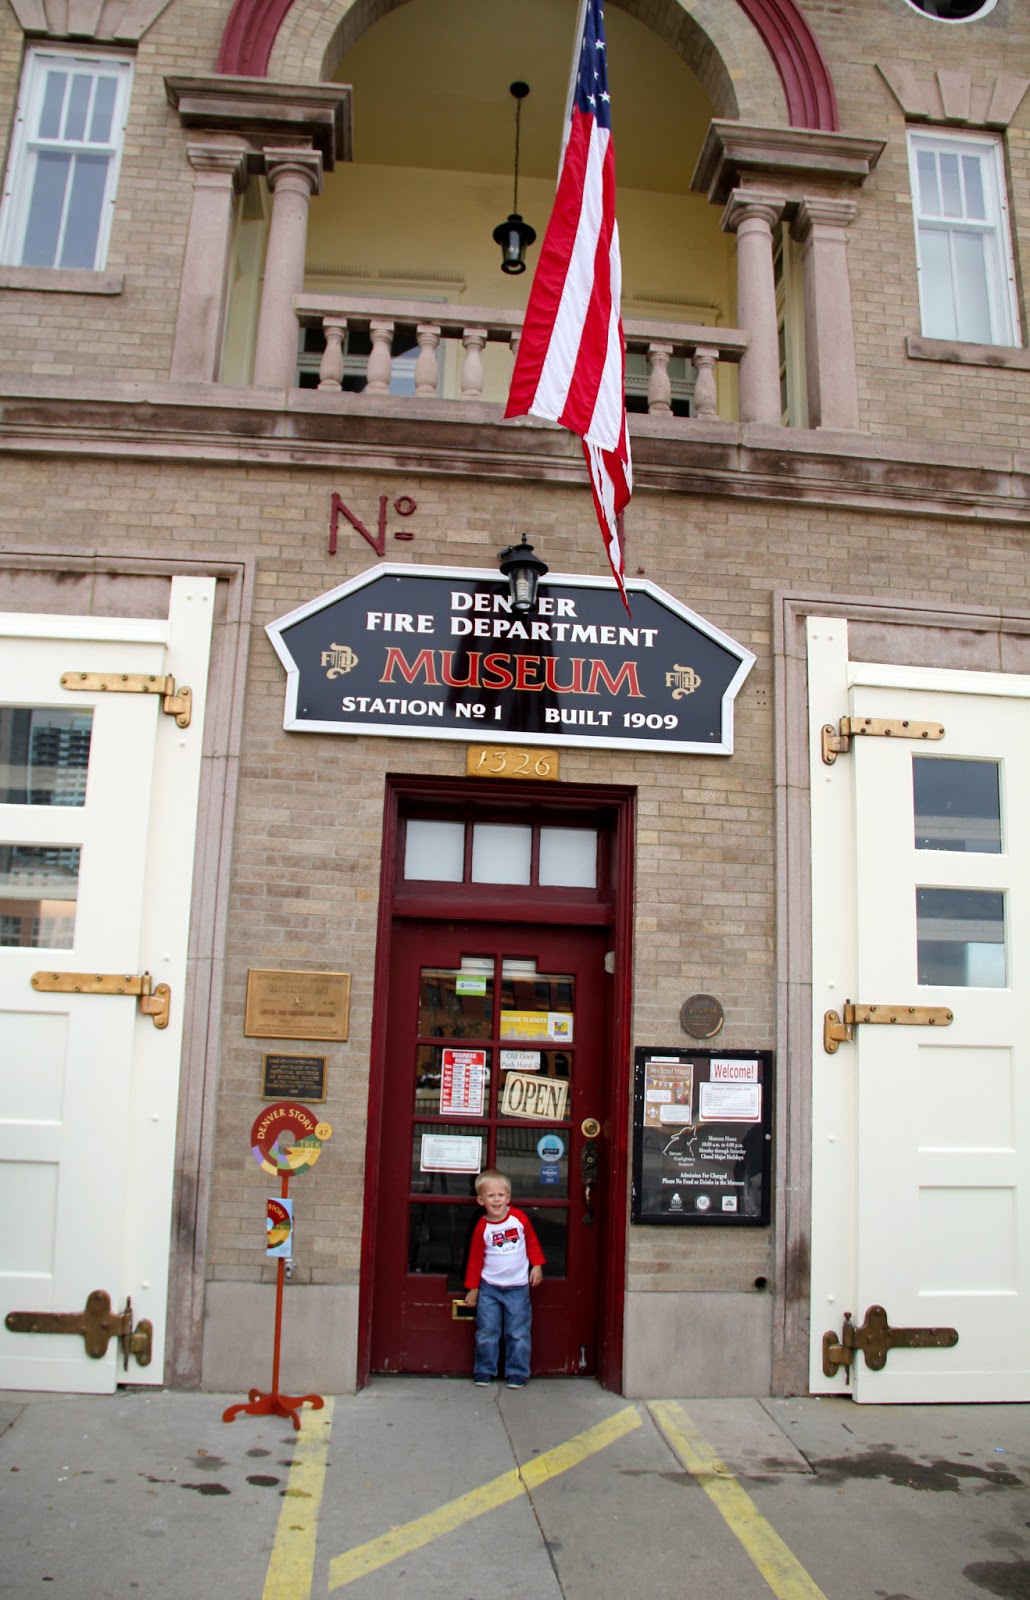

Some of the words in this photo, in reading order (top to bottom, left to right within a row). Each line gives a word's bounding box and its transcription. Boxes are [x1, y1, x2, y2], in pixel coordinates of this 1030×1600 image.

[450, 591, 578, 617] DENER
[366, 611, 435, 634] FIRE
[450, 616, 659, 648] DEPARTMENT
[378, 646, 647, 698] MUSEUM
[342, 696, 444, 717] STATION
[494, 704, 503, 720] 1
[545, 707, 612, 726] BUILT
[623, 712, 679, 730] 1909
[475, 750, 551, 777] 1326
[506, 1052, 518, 1060] Old
[713, 1063, 754, 1079] Welcome!
[508, 1078, 563, 1118] OPEN
[257, 1108, 286, 1140] DENVER
[288, 1108, 314, 1132] STORY
[318, 1129, 328, 1137] 47
[299, 1140, 321, 1149] TREK
[268, 1203, 286, 1219] STORY
